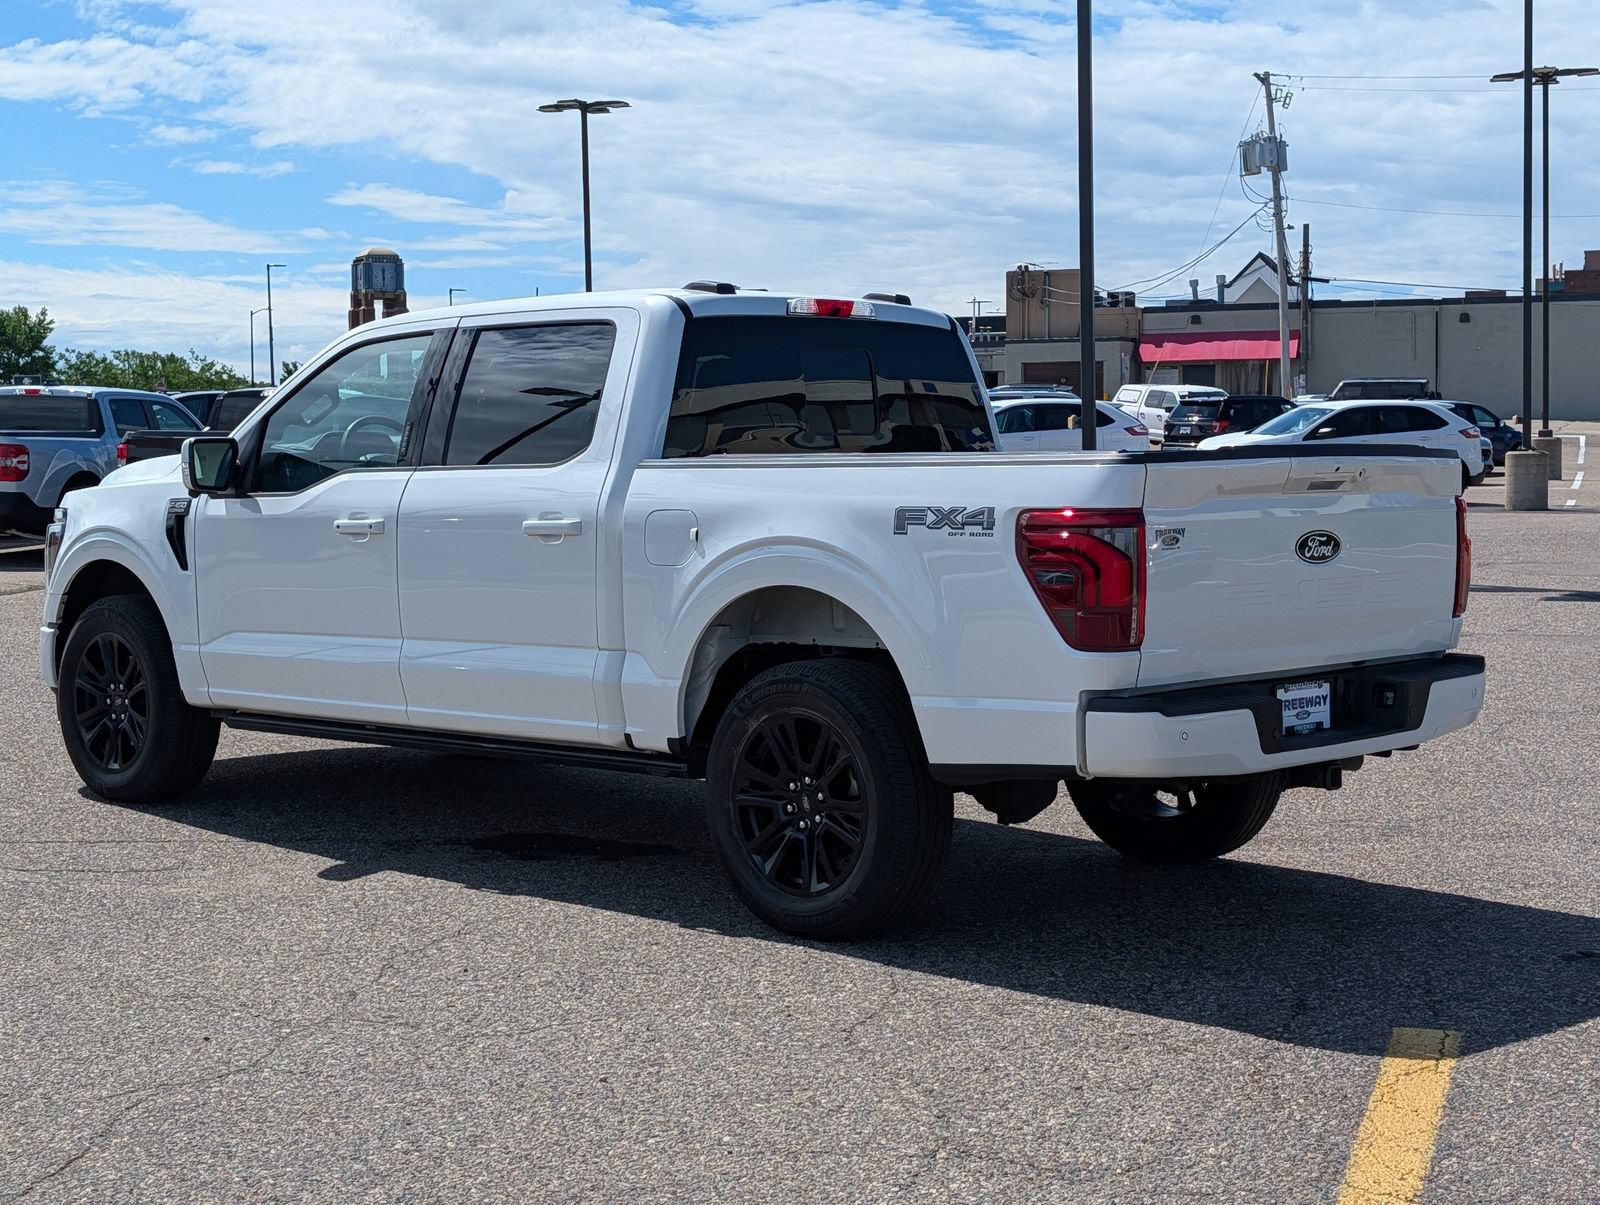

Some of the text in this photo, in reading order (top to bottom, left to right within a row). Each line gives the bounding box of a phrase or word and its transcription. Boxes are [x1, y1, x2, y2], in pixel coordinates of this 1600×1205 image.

[893, 506, 995, 535] FX4
[1305, 536, 1334, 557] Ford
[1284, 694, 1329, 711] REEWAY
